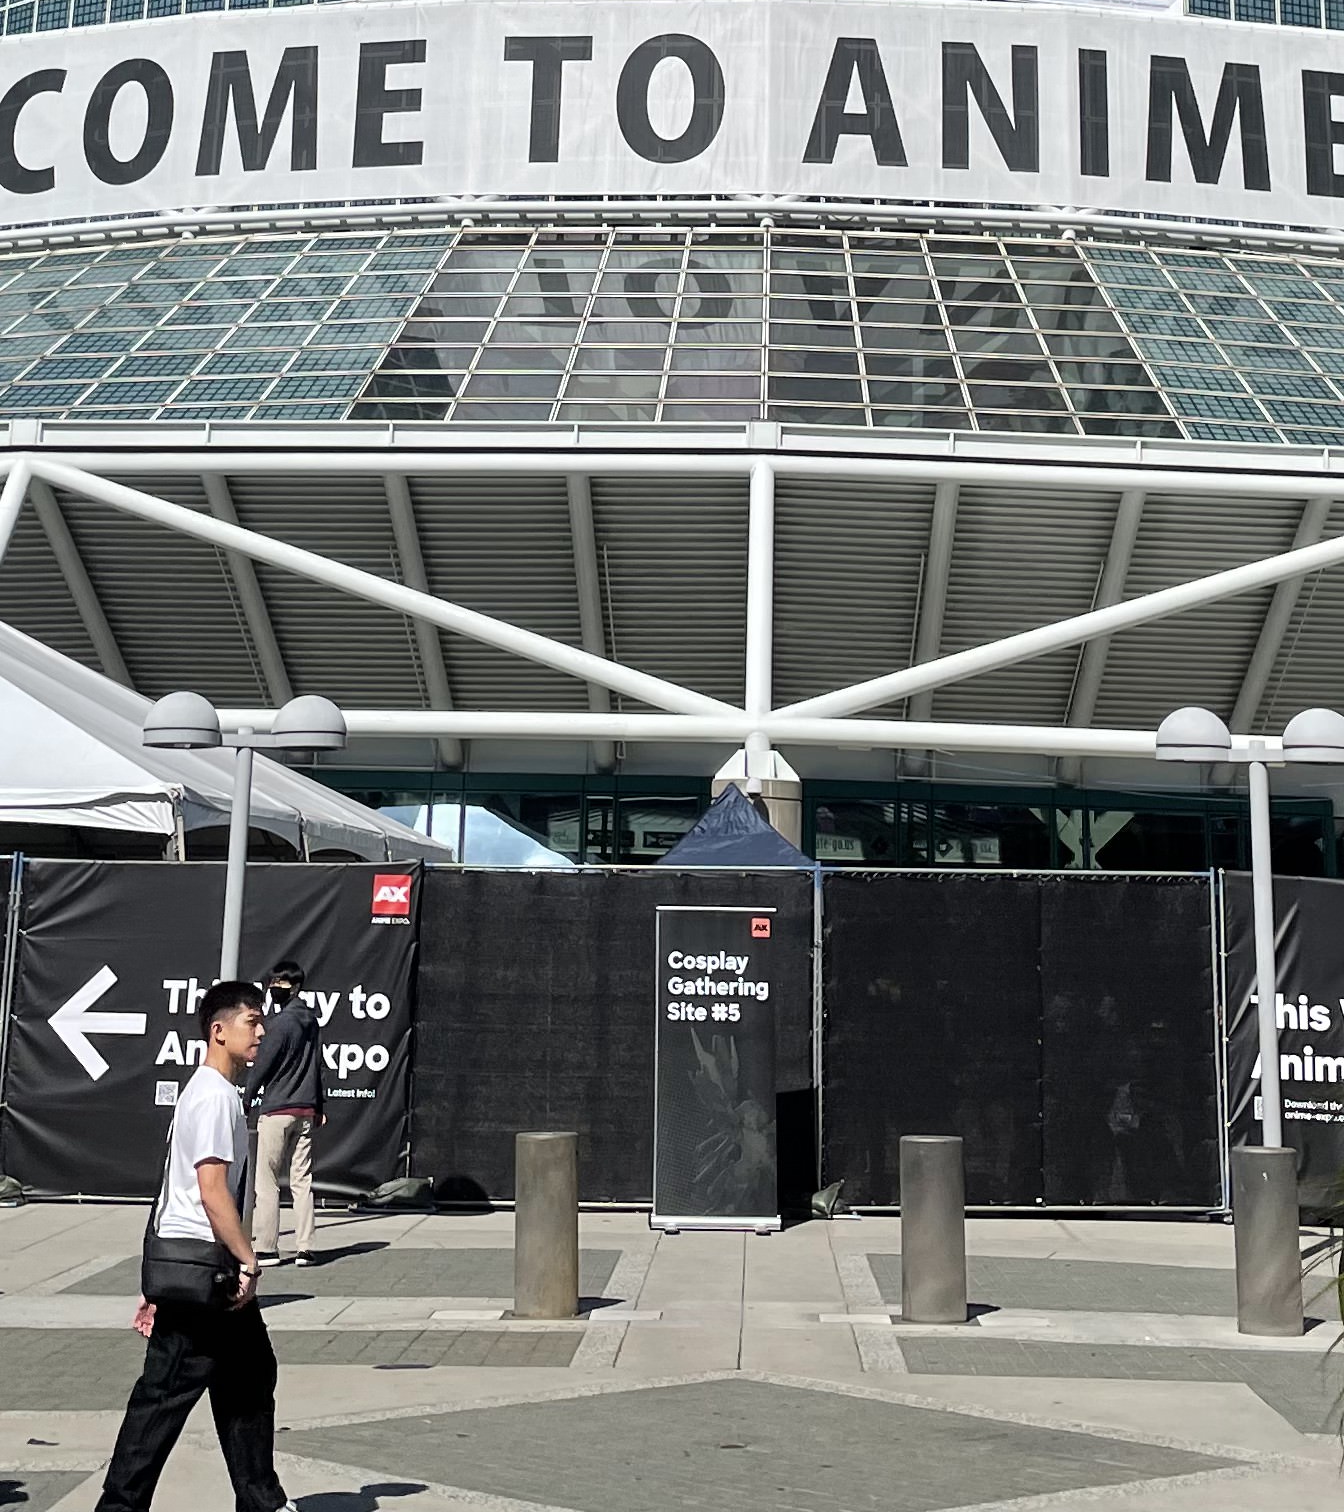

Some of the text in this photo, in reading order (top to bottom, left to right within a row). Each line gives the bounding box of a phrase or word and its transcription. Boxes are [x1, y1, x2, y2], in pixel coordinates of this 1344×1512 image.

[503, 33, 726, 164] TO
[373, 886, 409, 903] AX
[667, 950, 749, 974] Cosplay
[667, 976, 769, 1001] Gathering
[349, 984, 391, 1020] to
[667, 1002, 741, 1022] Site #5
[1250, 993, 1332, 1032] his
[323, 1043, 390, 1080] xpo
[327, 1088, 355, 1098] Latest
